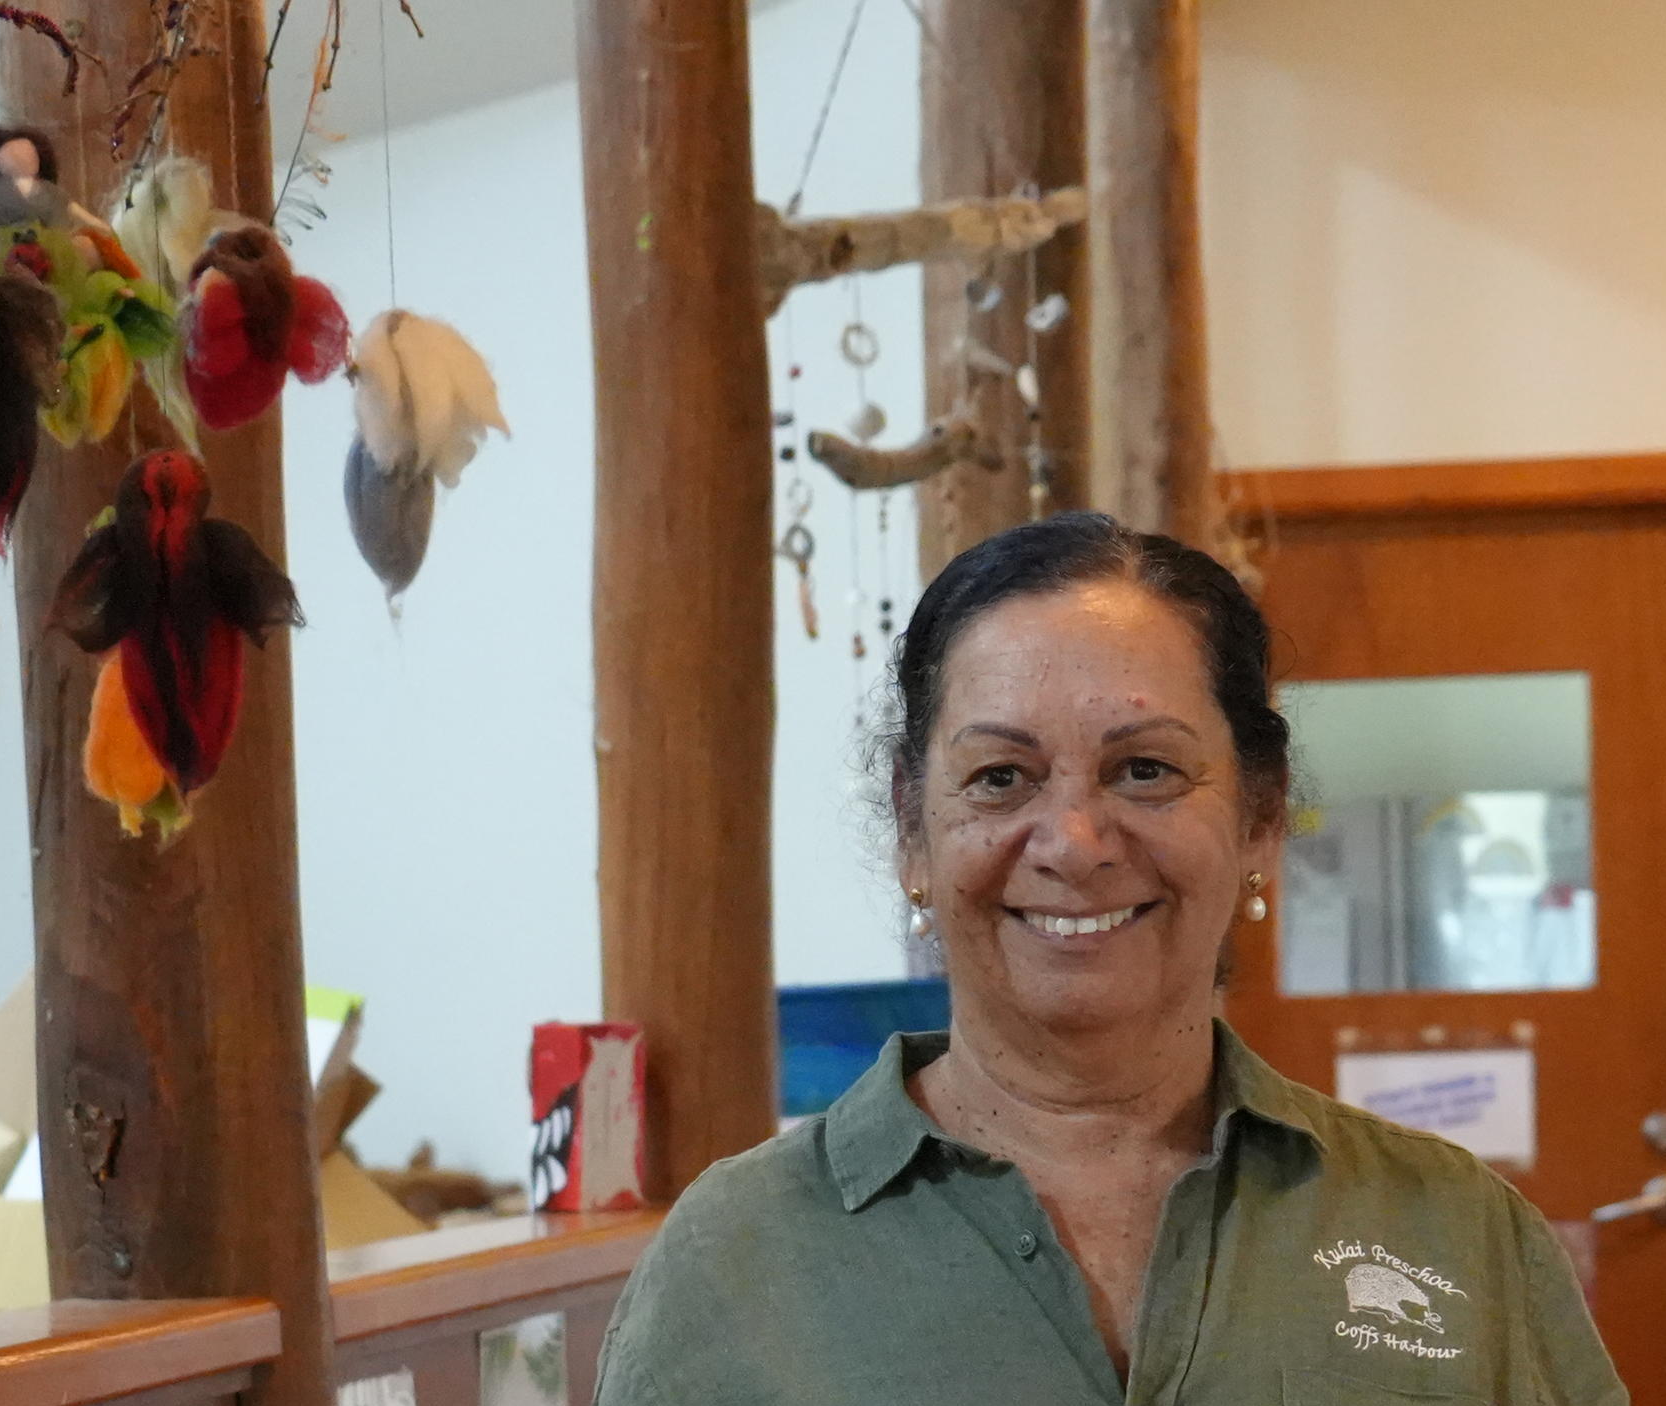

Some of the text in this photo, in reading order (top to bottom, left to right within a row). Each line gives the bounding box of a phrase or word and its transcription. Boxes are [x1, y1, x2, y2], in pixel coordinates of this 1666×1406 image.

[1314, 1240, 1467, 1299] Kulai Preschool
[1335, 1321, 1464, 1359] Coffs Harbour
